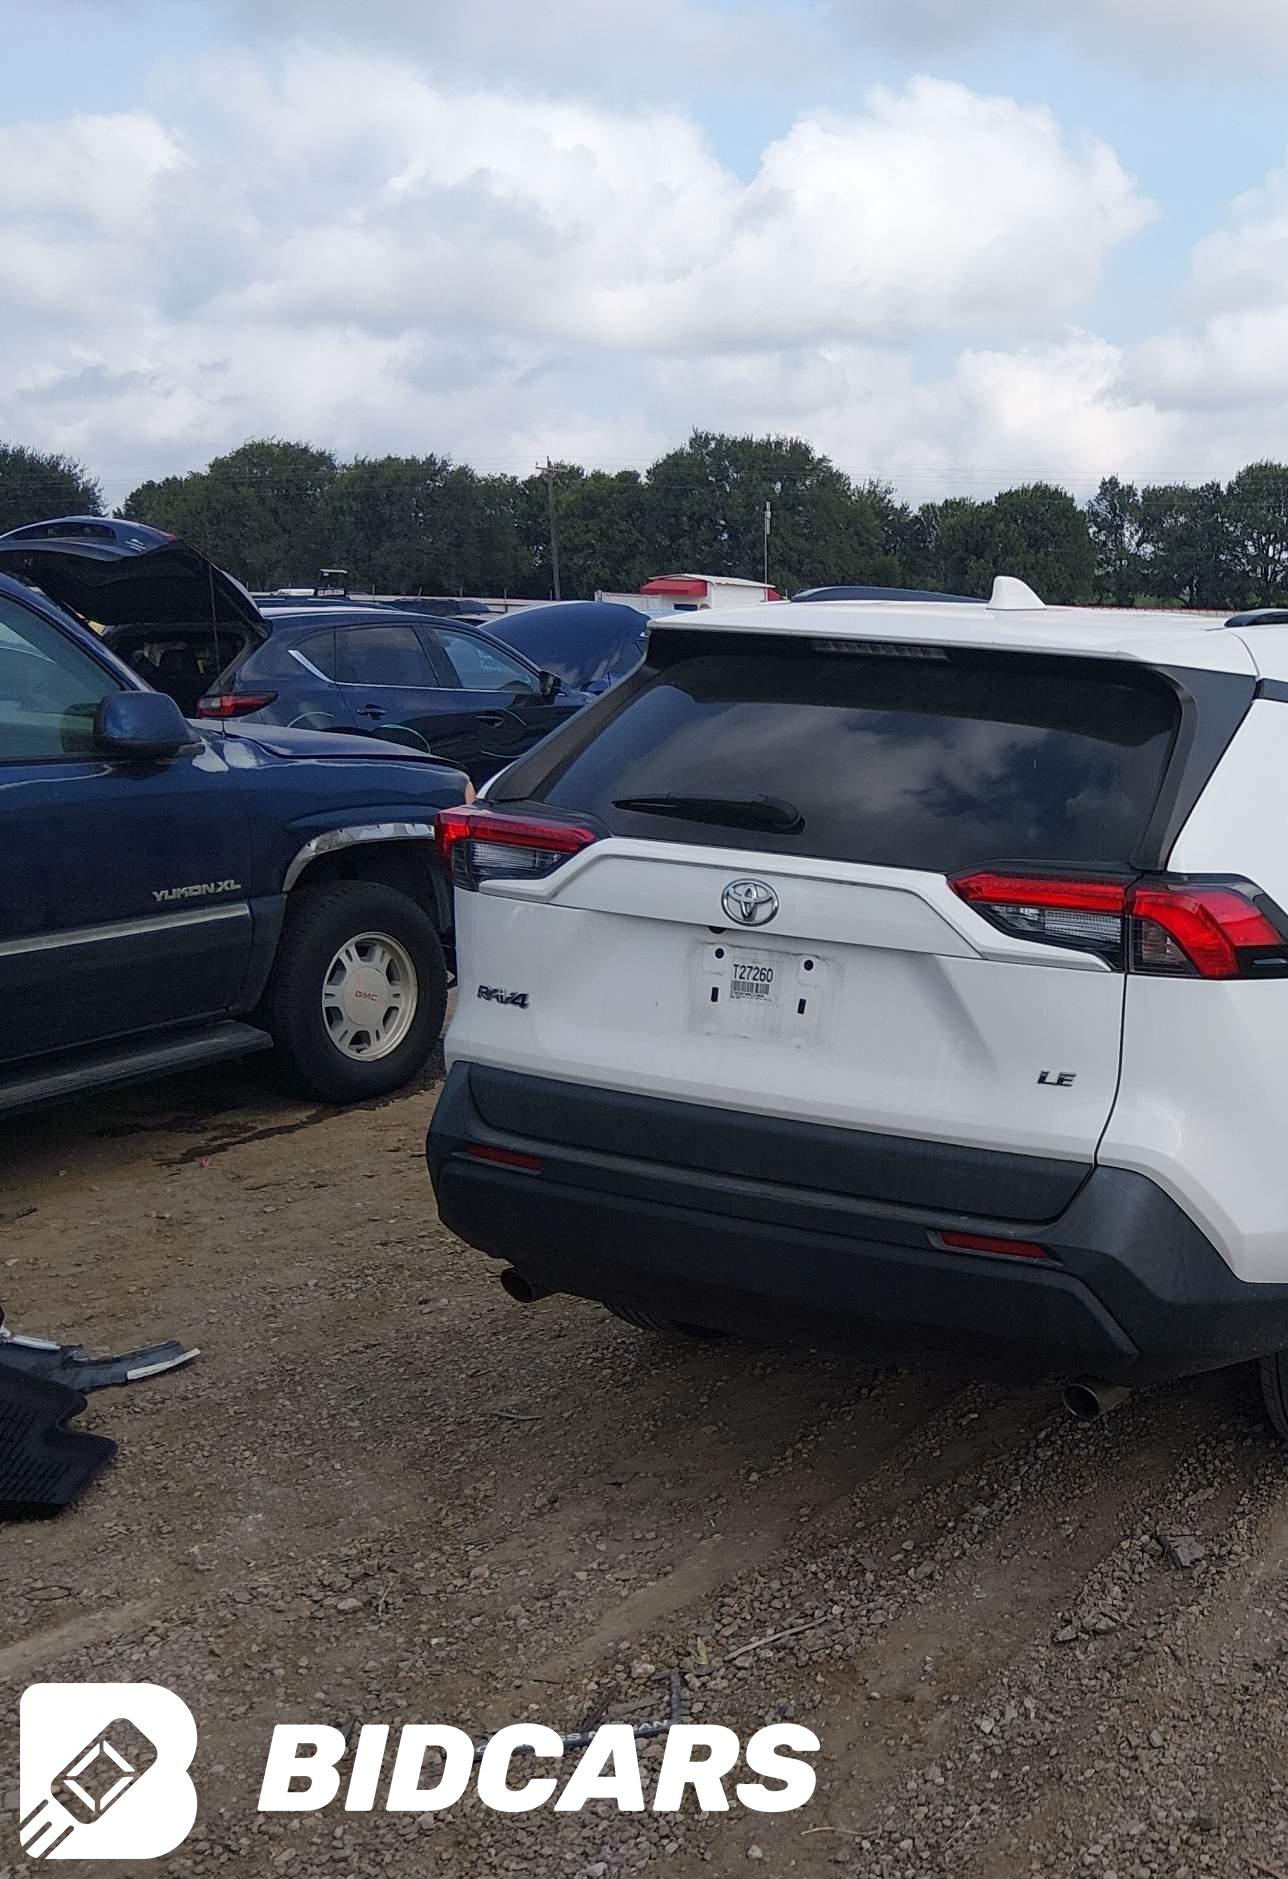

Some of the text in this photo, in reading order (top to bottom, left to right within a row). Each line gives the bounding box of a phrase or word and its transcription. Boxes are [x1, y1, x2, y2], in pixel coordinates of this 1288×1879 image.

[152, 879, 242, 902] YUKON XL
[733, 964, 774, 982] T27260
[355, 990, 378, 1001] GMC
[477, 984, 529, 1009] RAV4
[1037, 1070, 1077, 1087] LE
